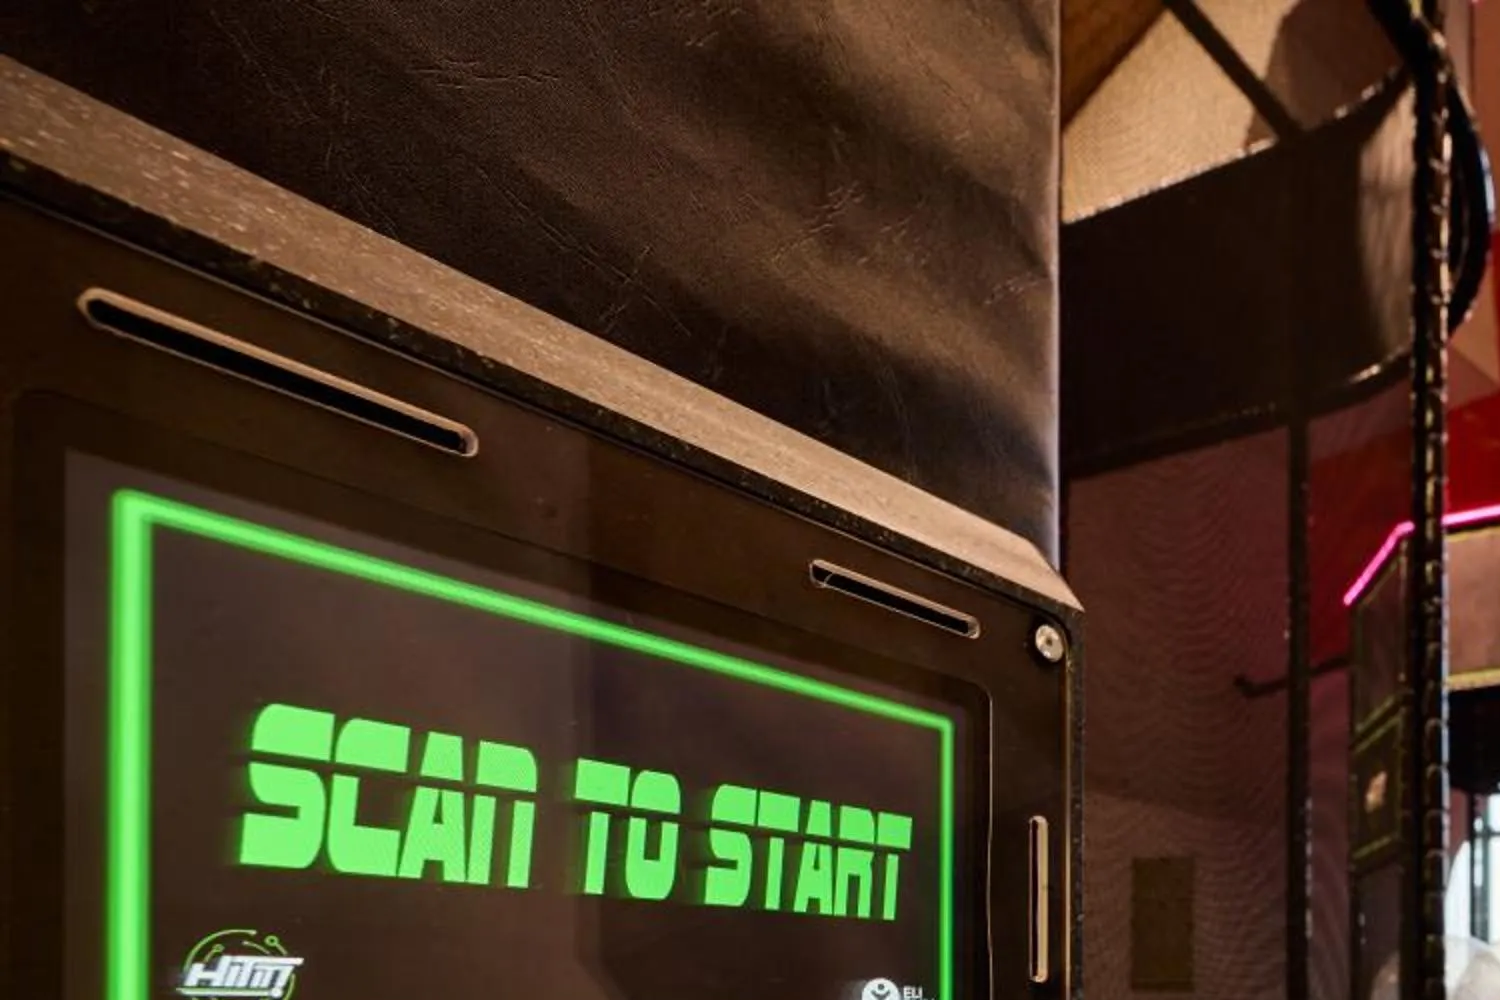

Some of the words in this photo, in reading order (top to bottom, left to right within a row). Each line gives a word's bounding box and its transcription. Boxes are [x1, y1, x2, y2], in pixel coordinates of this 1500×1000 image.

[239, 703, 538, 889] SCAN
[574, 758, 681, 900] TO
[704, 784, 913, 921] START
[903, 985, 923, 998] ELI
